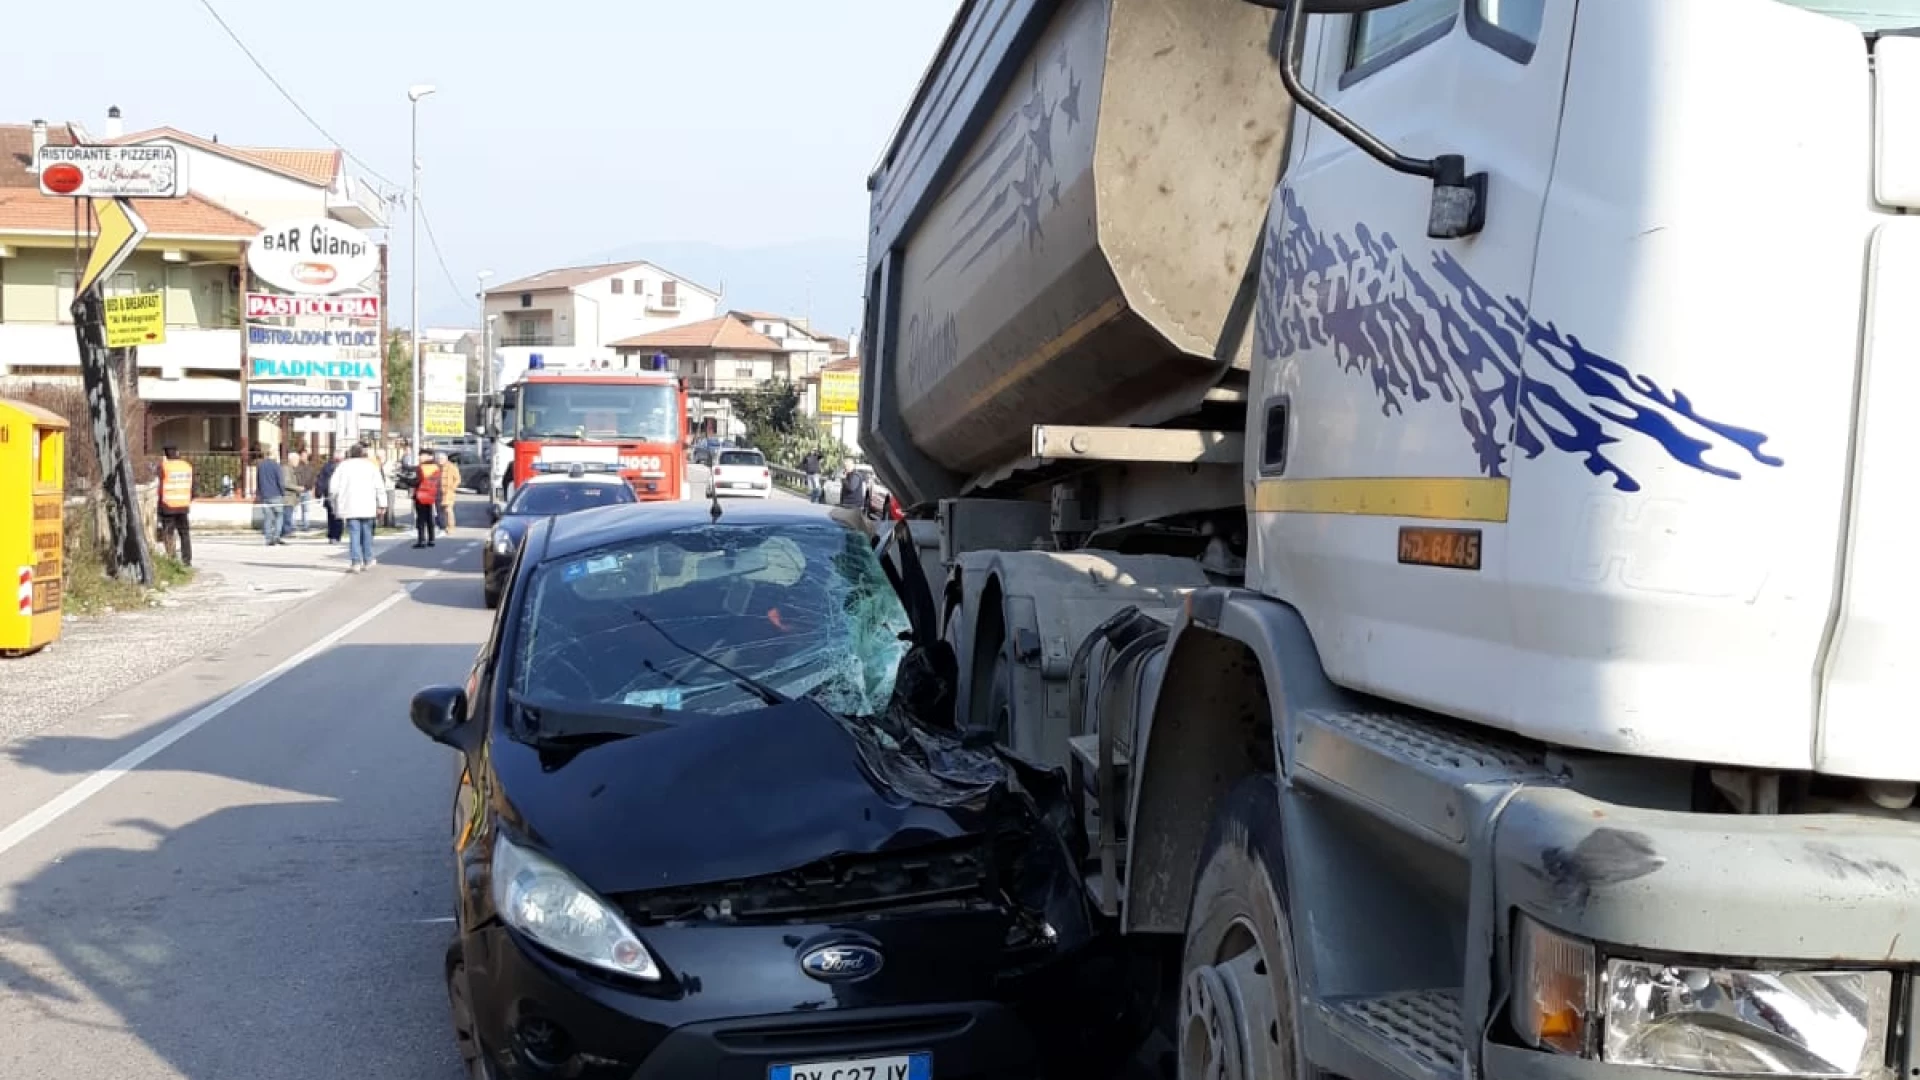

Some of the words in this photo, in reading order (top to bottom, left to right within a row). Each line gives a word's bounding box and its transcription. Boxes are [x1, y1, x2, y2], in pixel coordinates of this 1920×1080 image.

[40, 148, 111, 161] RISTORANTE
[120, 148, 172, 161] PIZZERIA
[263, 228, 299, 252] BAR
[310, 224, 366, 258] Gianpi
[249, 297, 376, 316] PASTICCERIA
[249, 327, 332, 346] RISTORAZIONE
[335, 330, 376, 347] VELOCE
[253, 358, 376, 378] PIADINERIA
[251, 393, 348, 408] PARCHEGGIO
[821, 951, 864, 971] Ford
